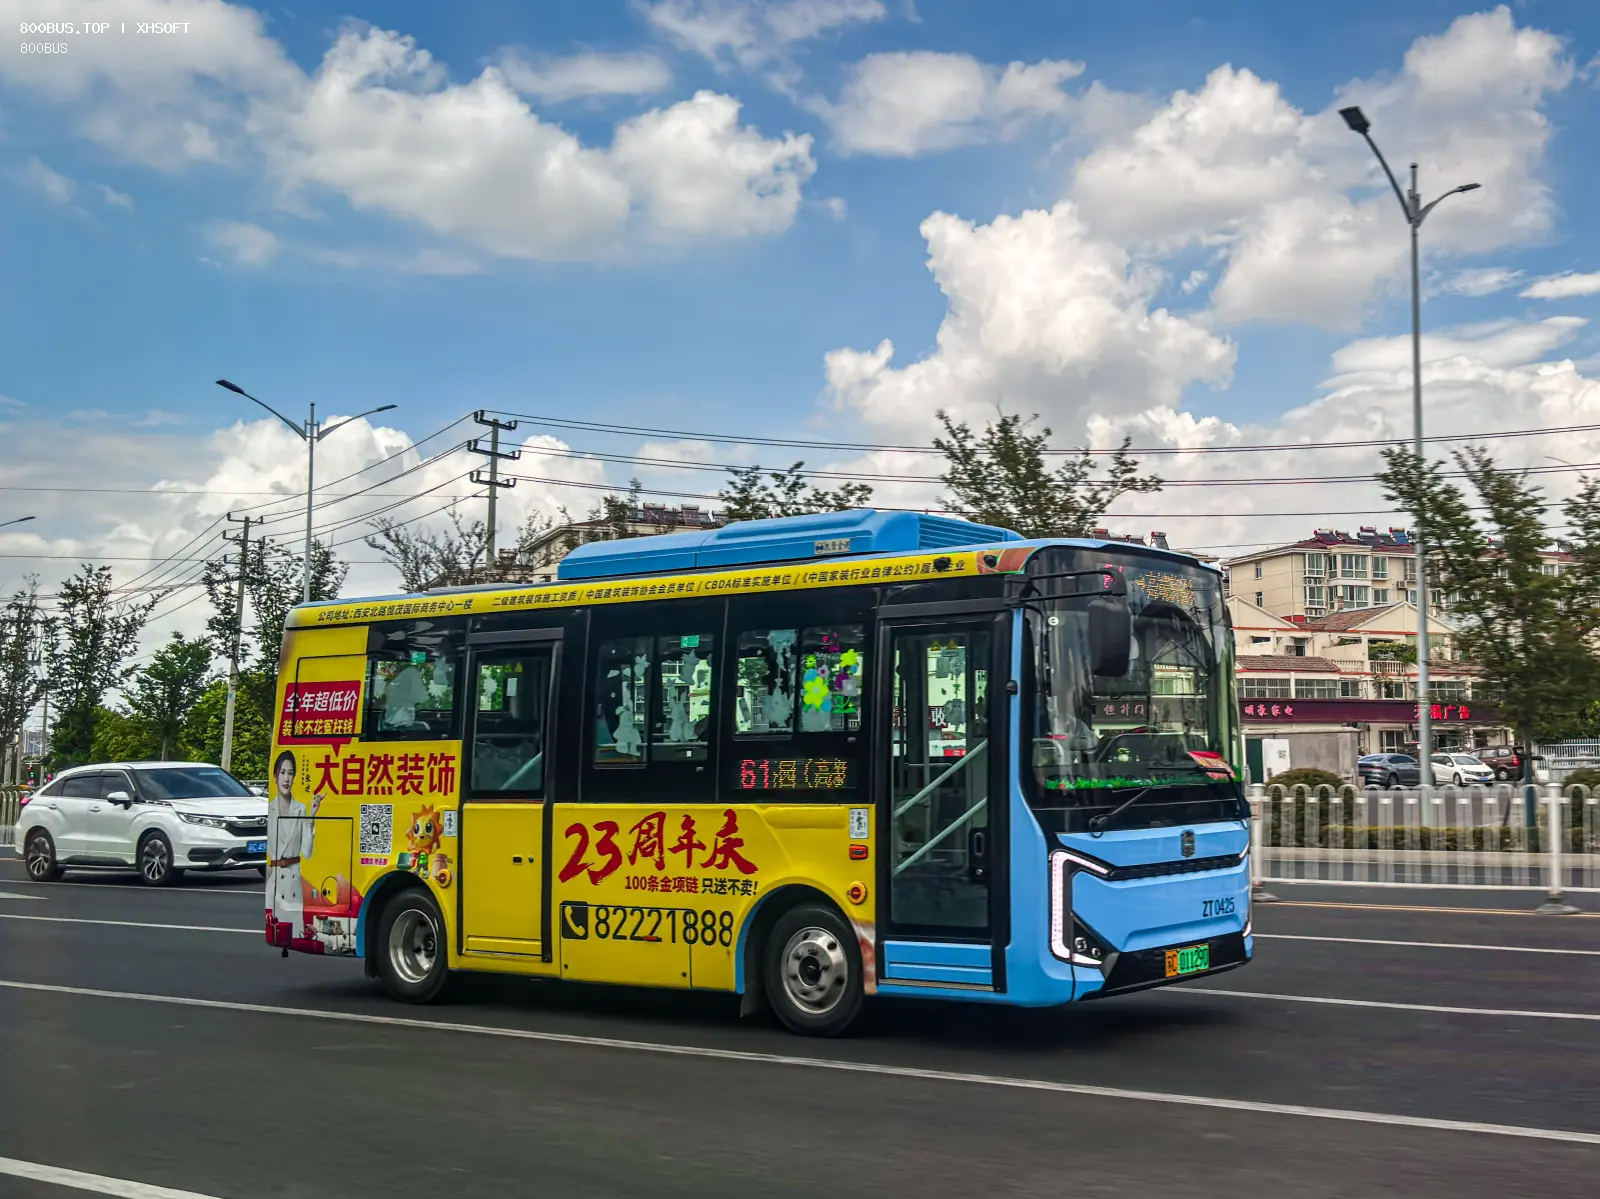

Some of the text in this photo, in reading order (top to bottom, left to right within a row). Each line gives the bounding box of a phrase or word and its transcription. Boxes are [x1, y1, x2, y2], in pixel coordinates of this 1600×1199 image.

[284, 690, 358, 713] 全年超低价
[281, 718, 354, 737] 装修不花冤枉钱
[313, 752, 456, 797] 大自然装饰
[740, 759, 770, 789] 61
[558, 808, 759, 886] 23周年庆
[625, 875, 758, 897] 100条金项链 只送不卖!
[1202, 897, 1235, 918] ZT0425
[594, 905, 735, 948] 82221888
